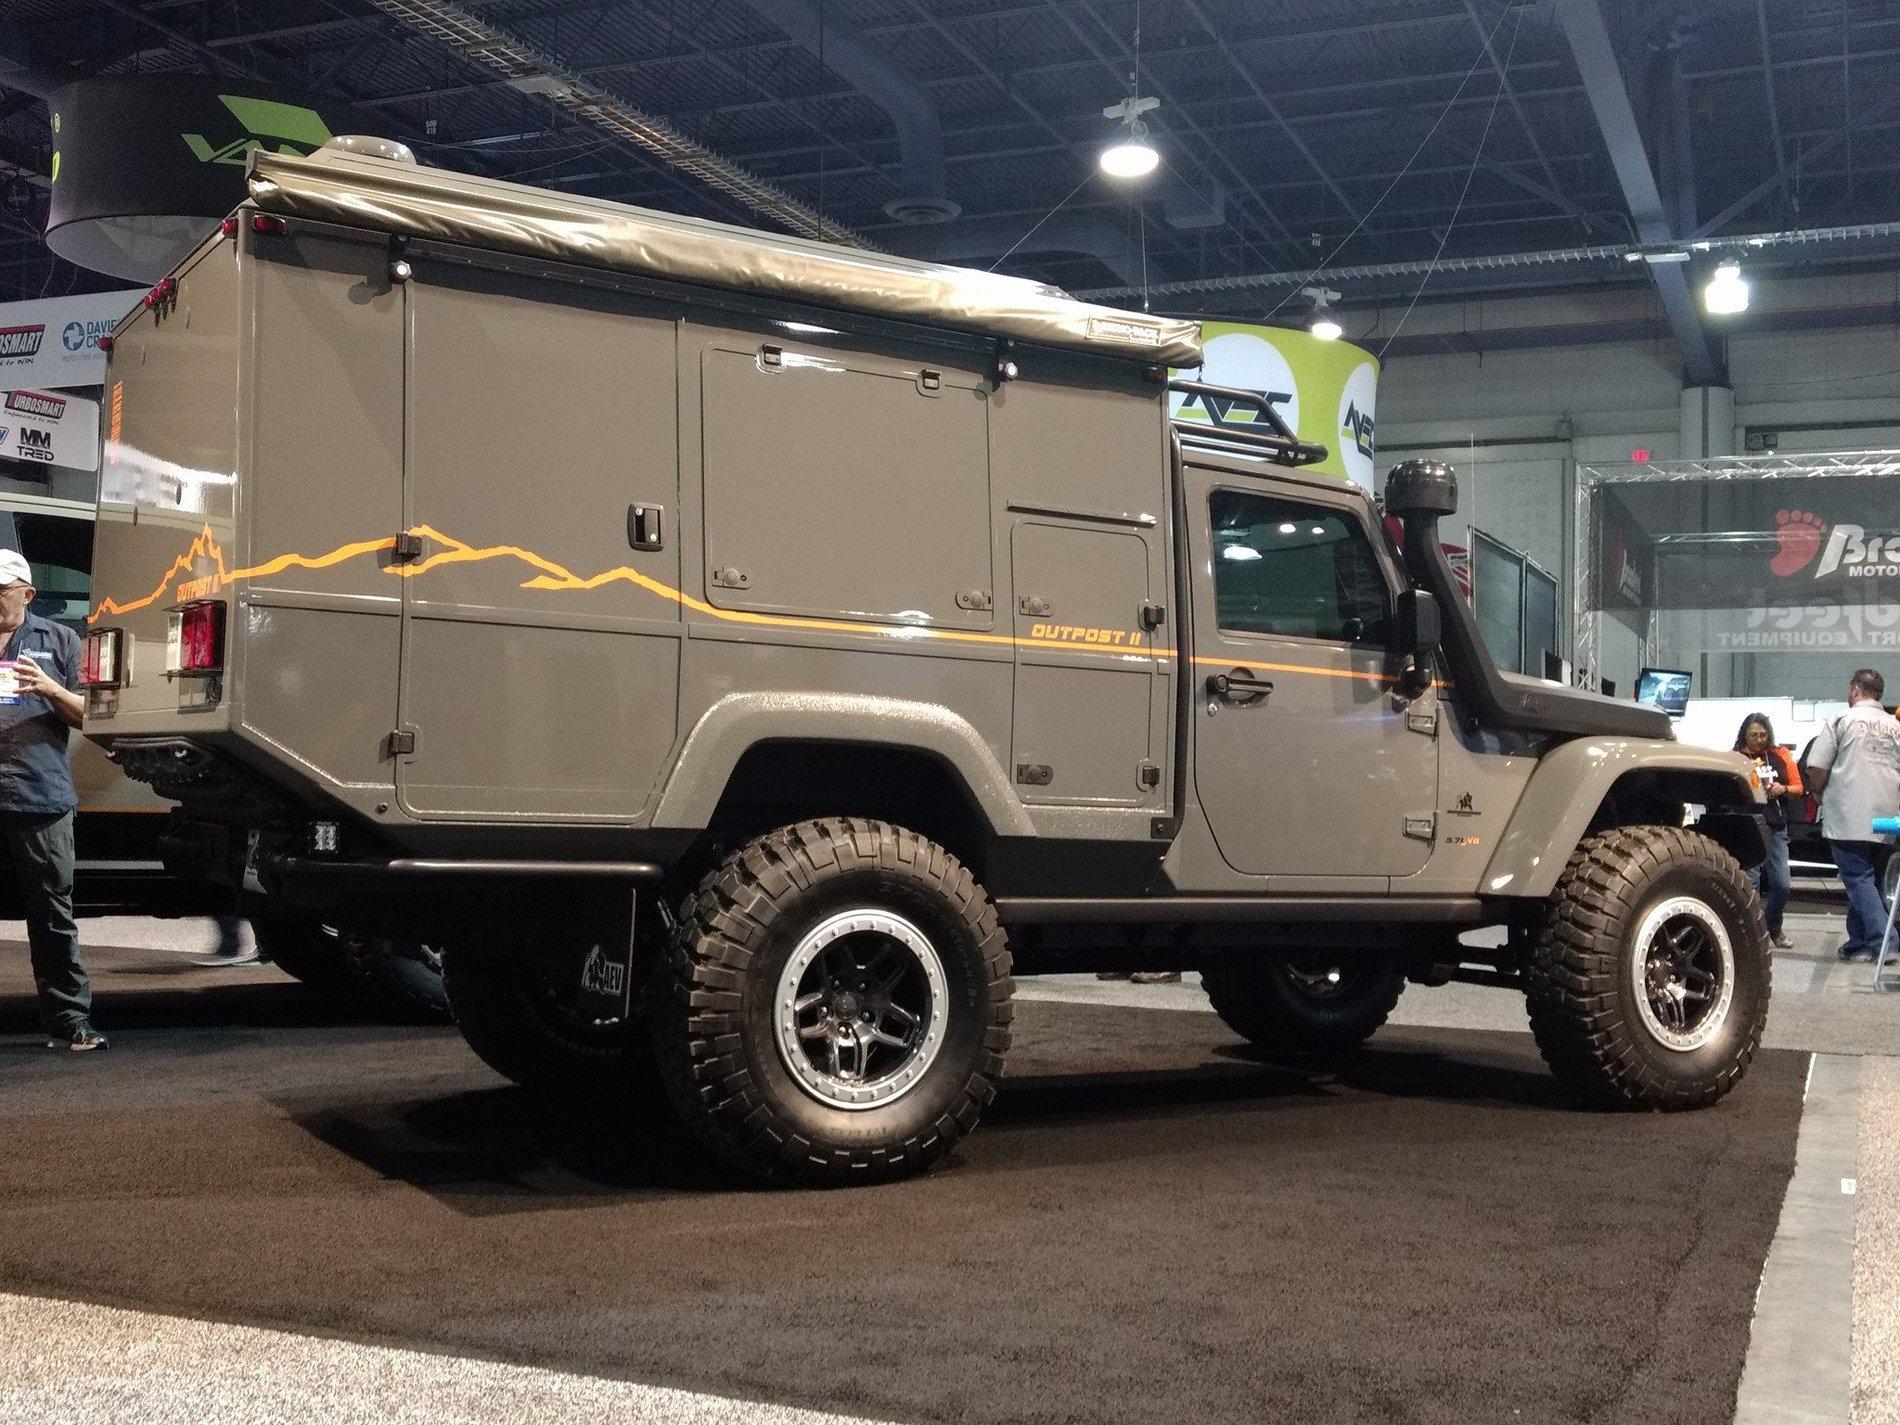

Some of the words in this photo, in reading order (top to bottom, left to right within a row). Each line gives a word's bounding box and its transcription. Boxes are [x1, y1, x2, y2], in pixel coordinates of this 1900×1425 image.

[17, 445, 54, 462] TRED
[1849, 565, 1900, 577] MOTO
[1031, 623, 1126, 644] OUTPOST
[1129, 631, 1142, 646] II
